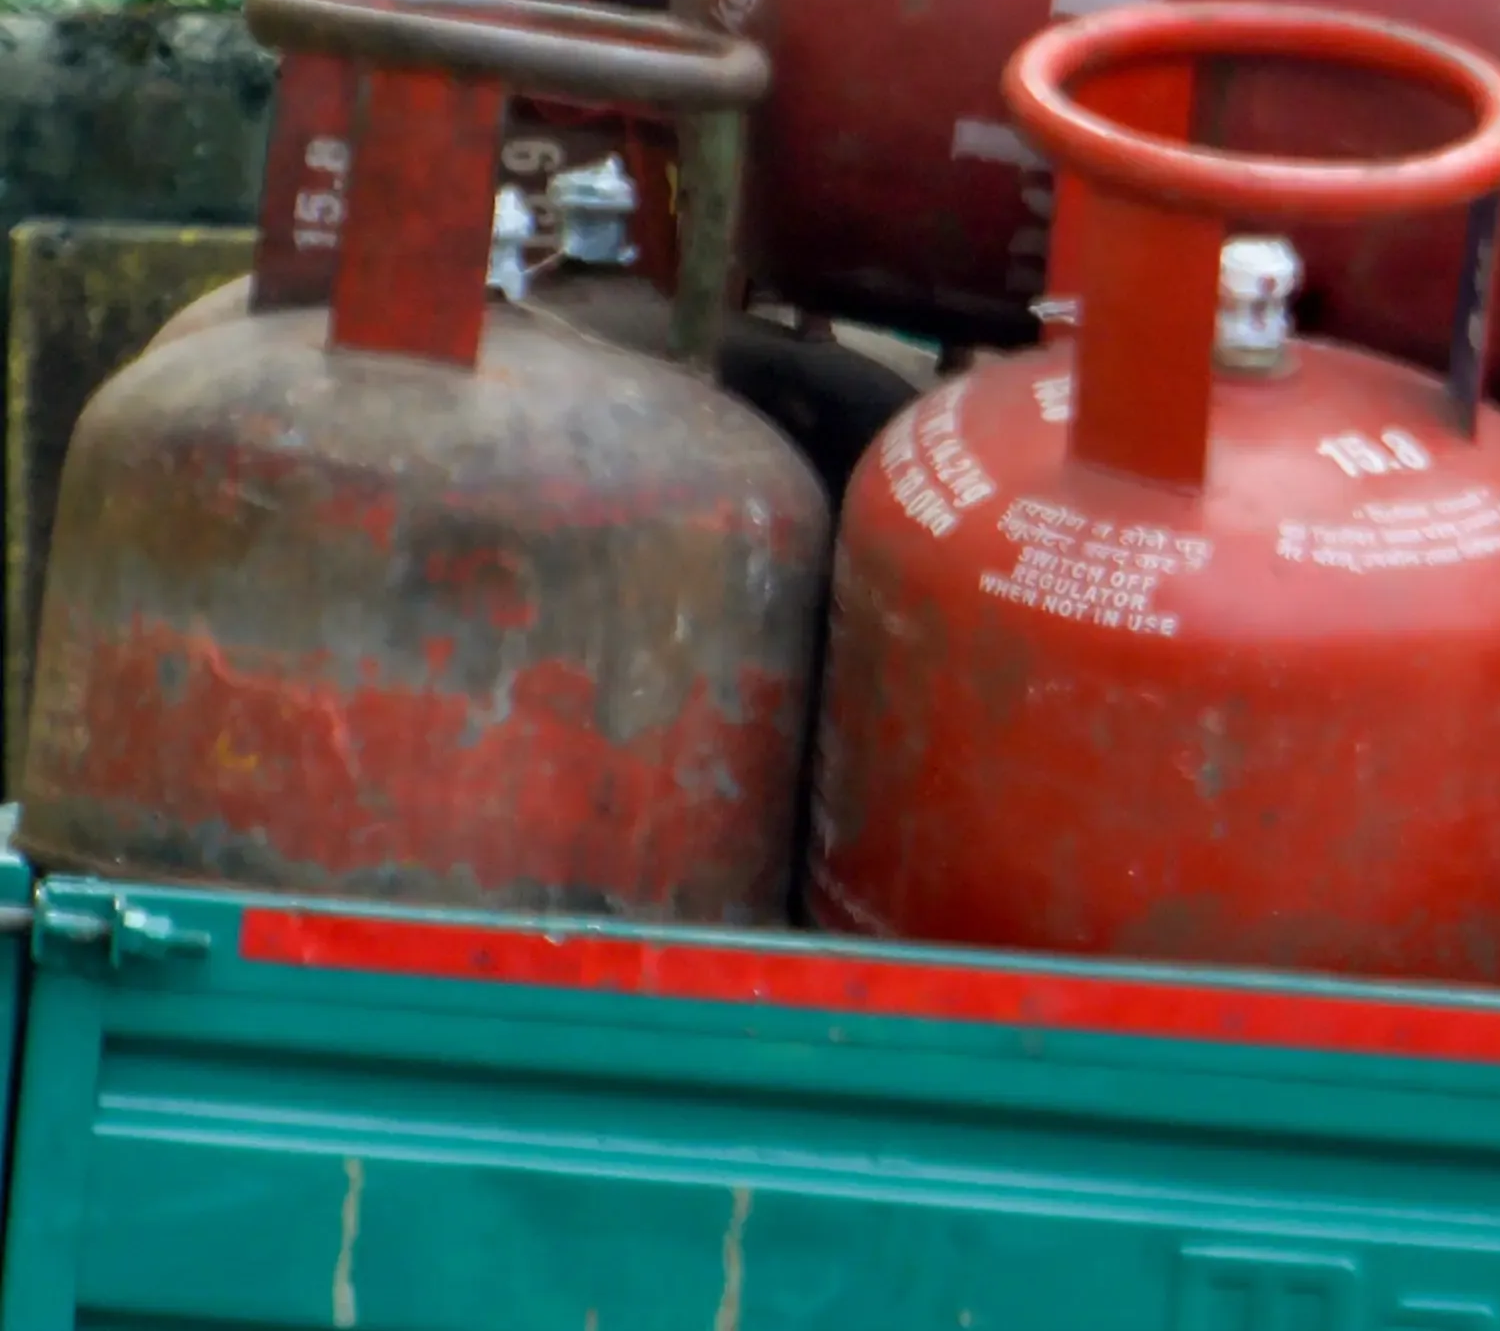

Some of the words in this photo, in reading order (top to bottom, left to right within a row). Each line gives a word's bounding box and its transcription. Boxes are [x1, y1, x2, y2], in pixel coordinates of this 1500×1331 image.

[1010, 564, 1149, 612] REGULATOR
[1017, 544, 1103, 584] SWITCH
[1108, 566, 1156, 593] OFF
[978, 574, 1035, 607] WHEN
[1040, 593, 1088, 622] NOT
[1094, 609, 1121, 630] IN
[1127, 611, 1179, 638] USE
